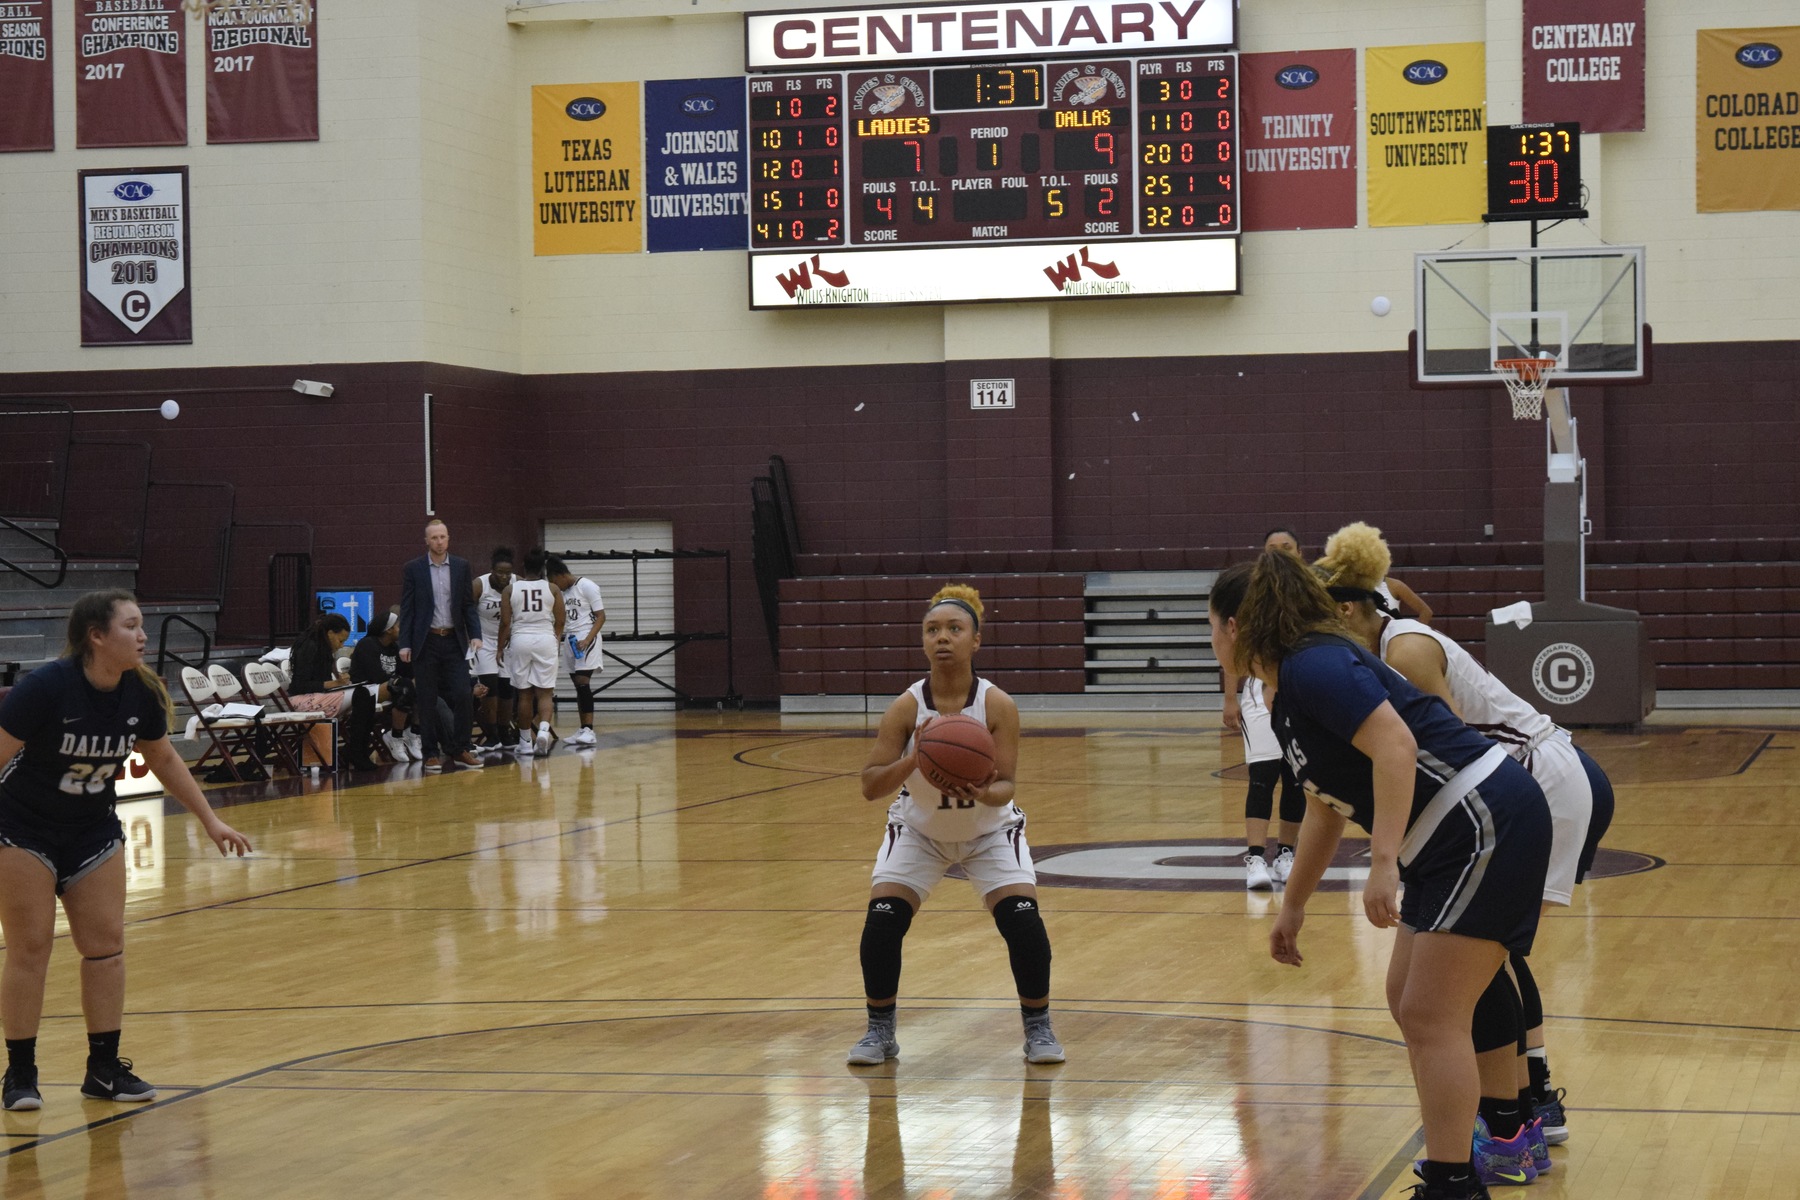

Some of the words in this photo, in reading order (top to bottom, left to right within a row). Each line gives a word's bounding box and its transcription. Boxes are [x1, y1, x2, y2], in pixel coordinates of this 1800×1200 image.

[96, 0, 165, 12] BASEBALL
[2, 22, 41, 38] SEASON
[92, 16, 169, 32] CONFERENCE
[208, 11, 237, 26] NCAA
[774, 1, 1204, 59] CENTENARY
[82, 31, 178, 57] CHAMPIONS
[212, 26, 311, 52] REGIONAL
[1531, 22, 1636, 50] CENTENARY
[214, 56, 254, 73] 2017
[1140, 63, 1162, 75] PLYR
[1176, 62, 1192, 73] FLS
[1208, 60, 1225, 71] PTS
[1741, 50, 1776, 62] SCAC
[85, 63, 125, 80] 2017
[1281, 71, 1314, 84] SCAC
[1409, 66, 1442, 79] SCAC
[1546, 56, 1621, 82] COLLEGE
[752, 81, 773, 93] PLYR
[786, 79, 801, 91] FLS
[816, 78, 832, 90] PTS
[853, 76, 880, 110] LADIES
[884, 73, 895, 84] &
[976, 68, 1039, 105] 1:37
[1053, 67, 1080, 102] LADIES
[1084, 64, 1096, 75] &
[1160, 81, 1170, 101] 3
[1180, 80, 1192, 100] 0
[1218, 78, 1230, 99] 2
[571, 103, 601, 116] SCAC
[684, 100, 714, 112] SCAC
[776, 100, 781, 117] 1
[790, 98, 801, 117] 0
[826, 96, 837, 116] 2
[858, 117, 930, 136] LADIES
[1055, 109, 1111, 128] DALLAS
[1151, 114, 1171, 130] 11
[1181, 111, 1193, 132] 0
[1218, 109, 1230, 130] 0
[1262, 113, 1333, 139] TRINITY
[1370, 108, 1482, 136] SOUTHWESTERN
[661, 130, 739, 155] JOHNSON
[763, 129, 781, 148] 10
[797, 130, 802, 146] 1
[826, 127, 837, 146] 0
[971, 126, 1008, 139] PERIOD
[1521, 130, 1570, 156] 1:37
[1715, 125, 1800, 151] COLLEGE
[561, 138, 612, 162] TEXAS
[904, 140, 921, 172] 7
[992, 143, 997, 166] 1
[1094, 132, 1114, 164] 9
[1144, 143, 1171, 164] 20
[1181, 143, 1193, 163] 0
[1218, 141, 1230, 161] 0
[1245, 145, 1351, 172] UNIVERSITY
[1385, 142, 1468, 168] UNIVERSITY
[664, 166, 679, 186] &
[681, 161, 738, 185] WALES
[763, 160, 781, 179] 12
[791, 159, 802, 179] 0
[833, 159, 838, 175] 1
[1084, 173, 1118, 185] FOULS
[116, 183, 150, 199] SCAC
[544, 169, 630, 194] LUTHERAN
[863, 182, 896, 194] FOULS
[910, 180, 940, 192] T.O.L.
[952, 178, 993, 191] PLAYER
[1001, 177, 1029, 188] FOUL
[1040, 175, 1071, 187] T.O.L.
[1145, 175, 1171, 195] 25
[1189, 176, 1194, 192] 1
[1218, 174, 1231, 191] 4
[1509, 159, 1559, 204] 30
[650, 192, 749, 218] UNIVERSITY
[764, 191, 782, 209] 15
[798, 191, 803, 207] 1
[827, 188, 838, 208] 0
[877, 198, 892, 221] 4
[917, 196, 933, 219] 4
[1047, 189, 1063, 217] 5
[1098, 187, 1114, 215] 2
[91, 209, 118, 221] MEN'S
[120, 207, 177, 220] BASKETBALL
[539, 200, 636, 225] UNIVERSITY
[1147, 206, 1171, 227] 32
[1182, 205, 1194, 225] 0
[1219, 204, 1231, 224] 0
[94, 225, 137, 240] REGULAR
[138, 223, 174, 238] SEASON
[757, 222, 783, 239] 41
[792, 220, 803, 239] 0
[828, 219, 839, 239] 2
[864, 229, 898, 242] SCORE
[972, 226, 1008, 238] MATCH
[1084, 222, 1119, 234] SCORE
[89, 239, 179, 263] CHAMPIONS
[111, 260, 158, 285] 2015
[126, 294, 146, 318] C
[977, 382, 1008, 390] SECTION
[977, 390, 1007, 405] 114
[521, 589, 542, 612] 15
[1534, 645, 1569, 677] CENTENARY
[1571, 647, 1592, 676] COLLEGE
[1550, 657, 1576, 689] C
[1540, 687, 1587, 702] BASKETBALL
[59, 733, 136, 757] DALLAS
